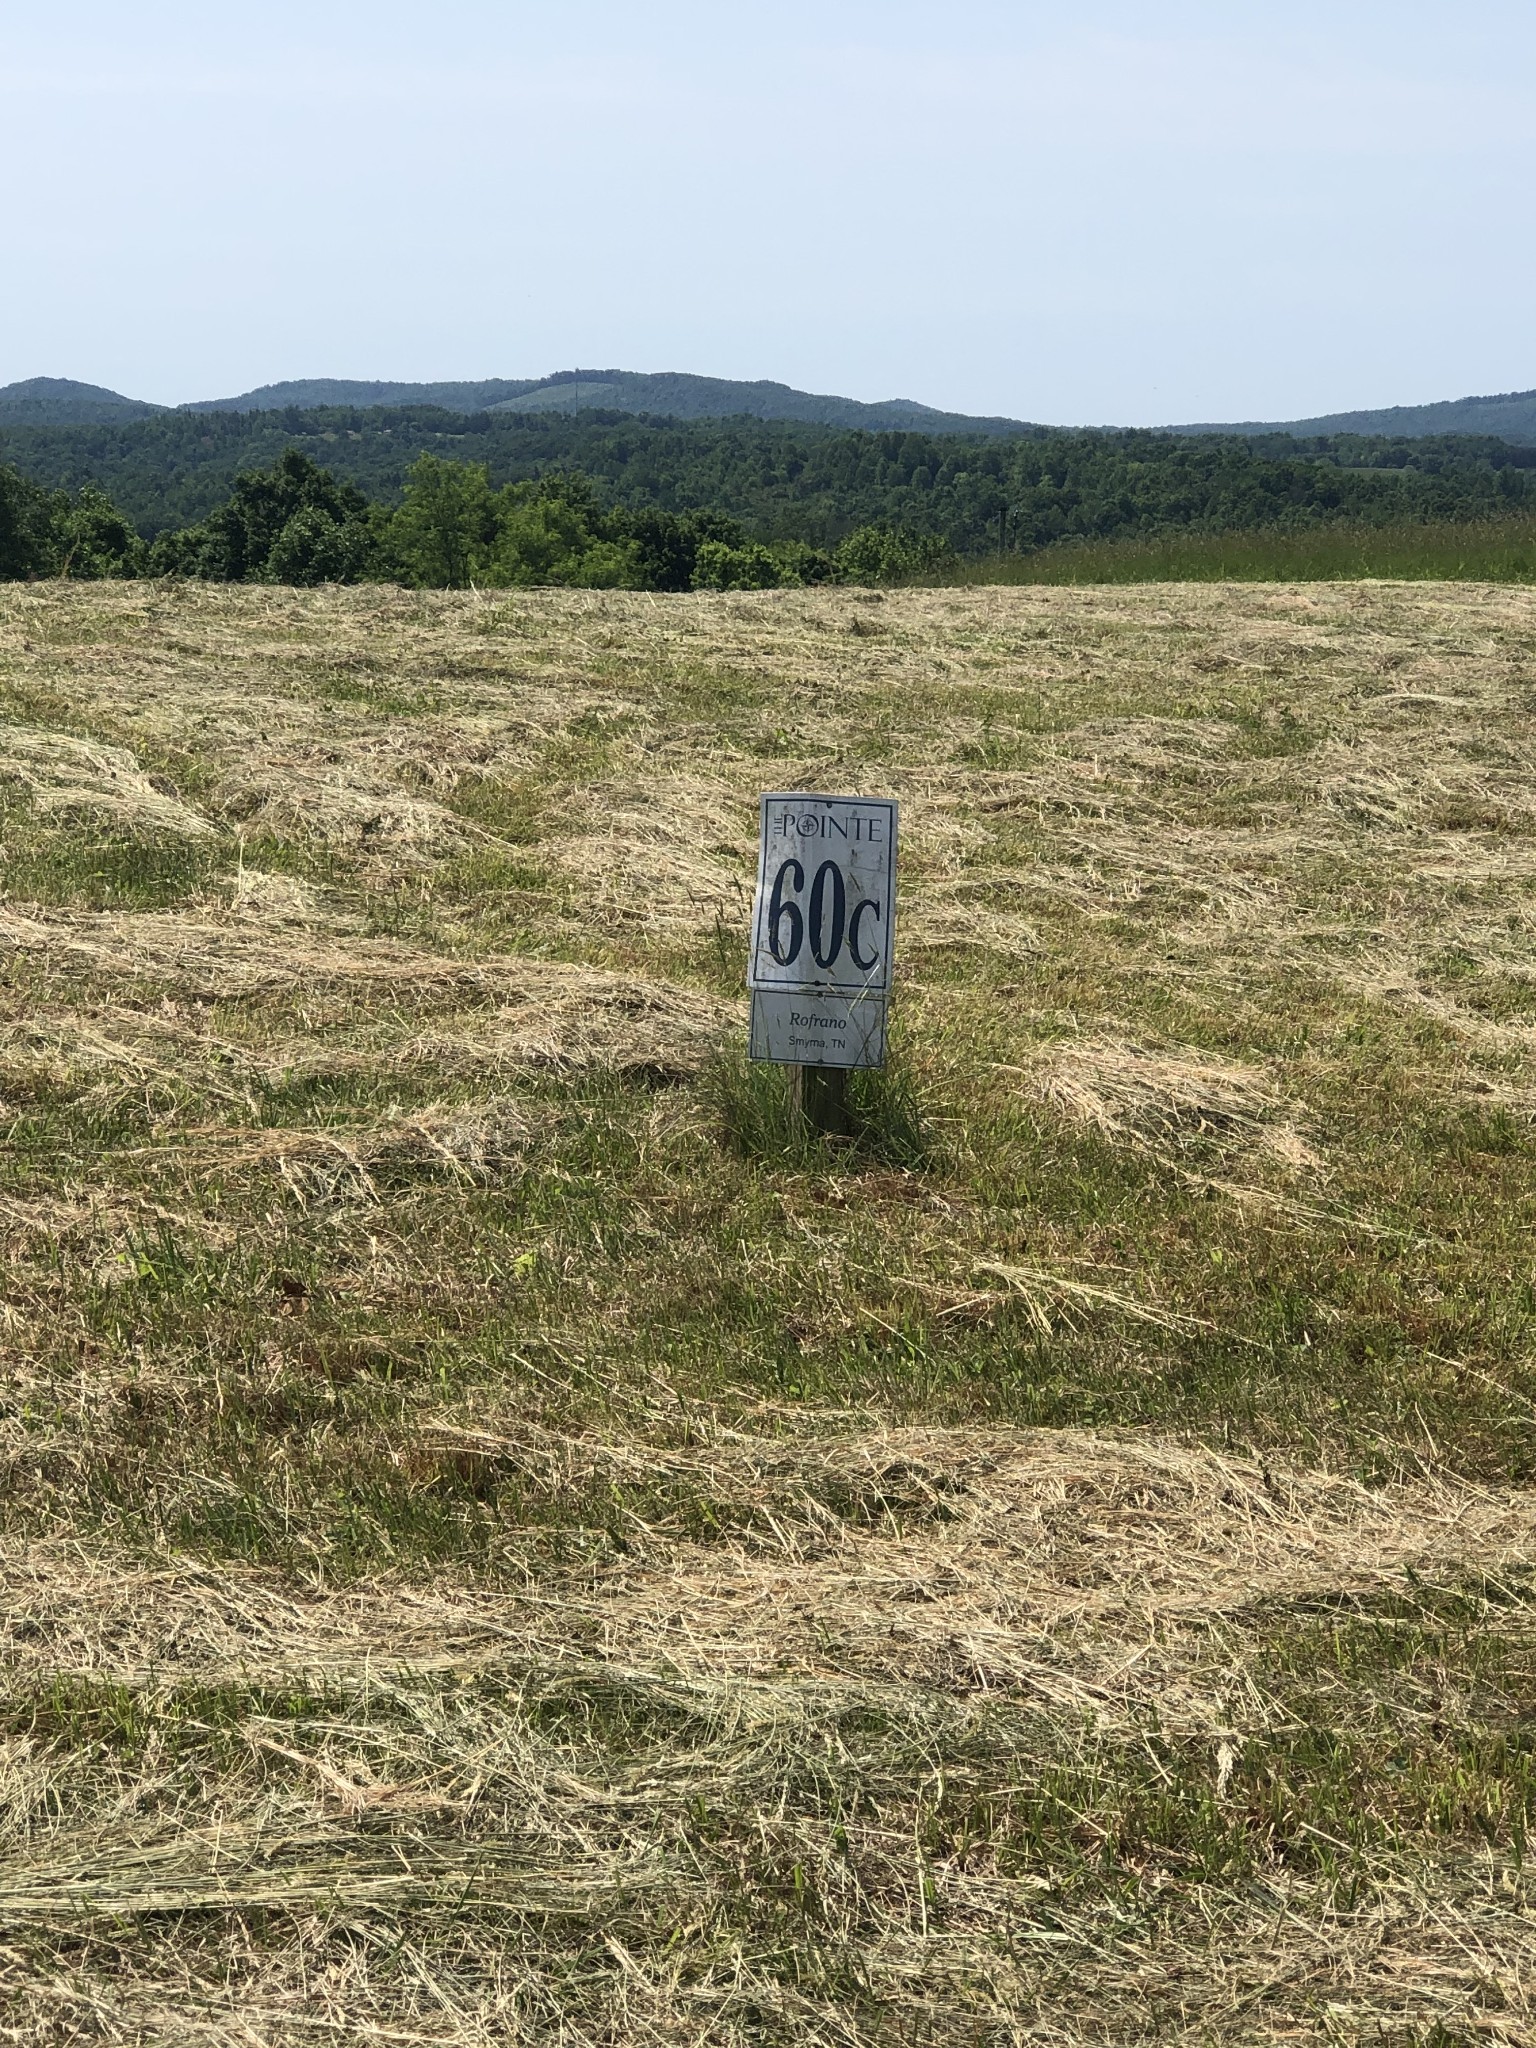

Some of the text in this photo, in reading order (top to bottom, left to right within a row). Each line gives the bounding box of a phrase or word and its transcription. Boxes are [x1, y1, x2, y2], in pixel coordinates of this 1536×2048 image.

[783, 813, 883, 843] POINTE
[789, 1012, 847, 1030] Rofrano
[831, 1038, 846, 1049] TN
